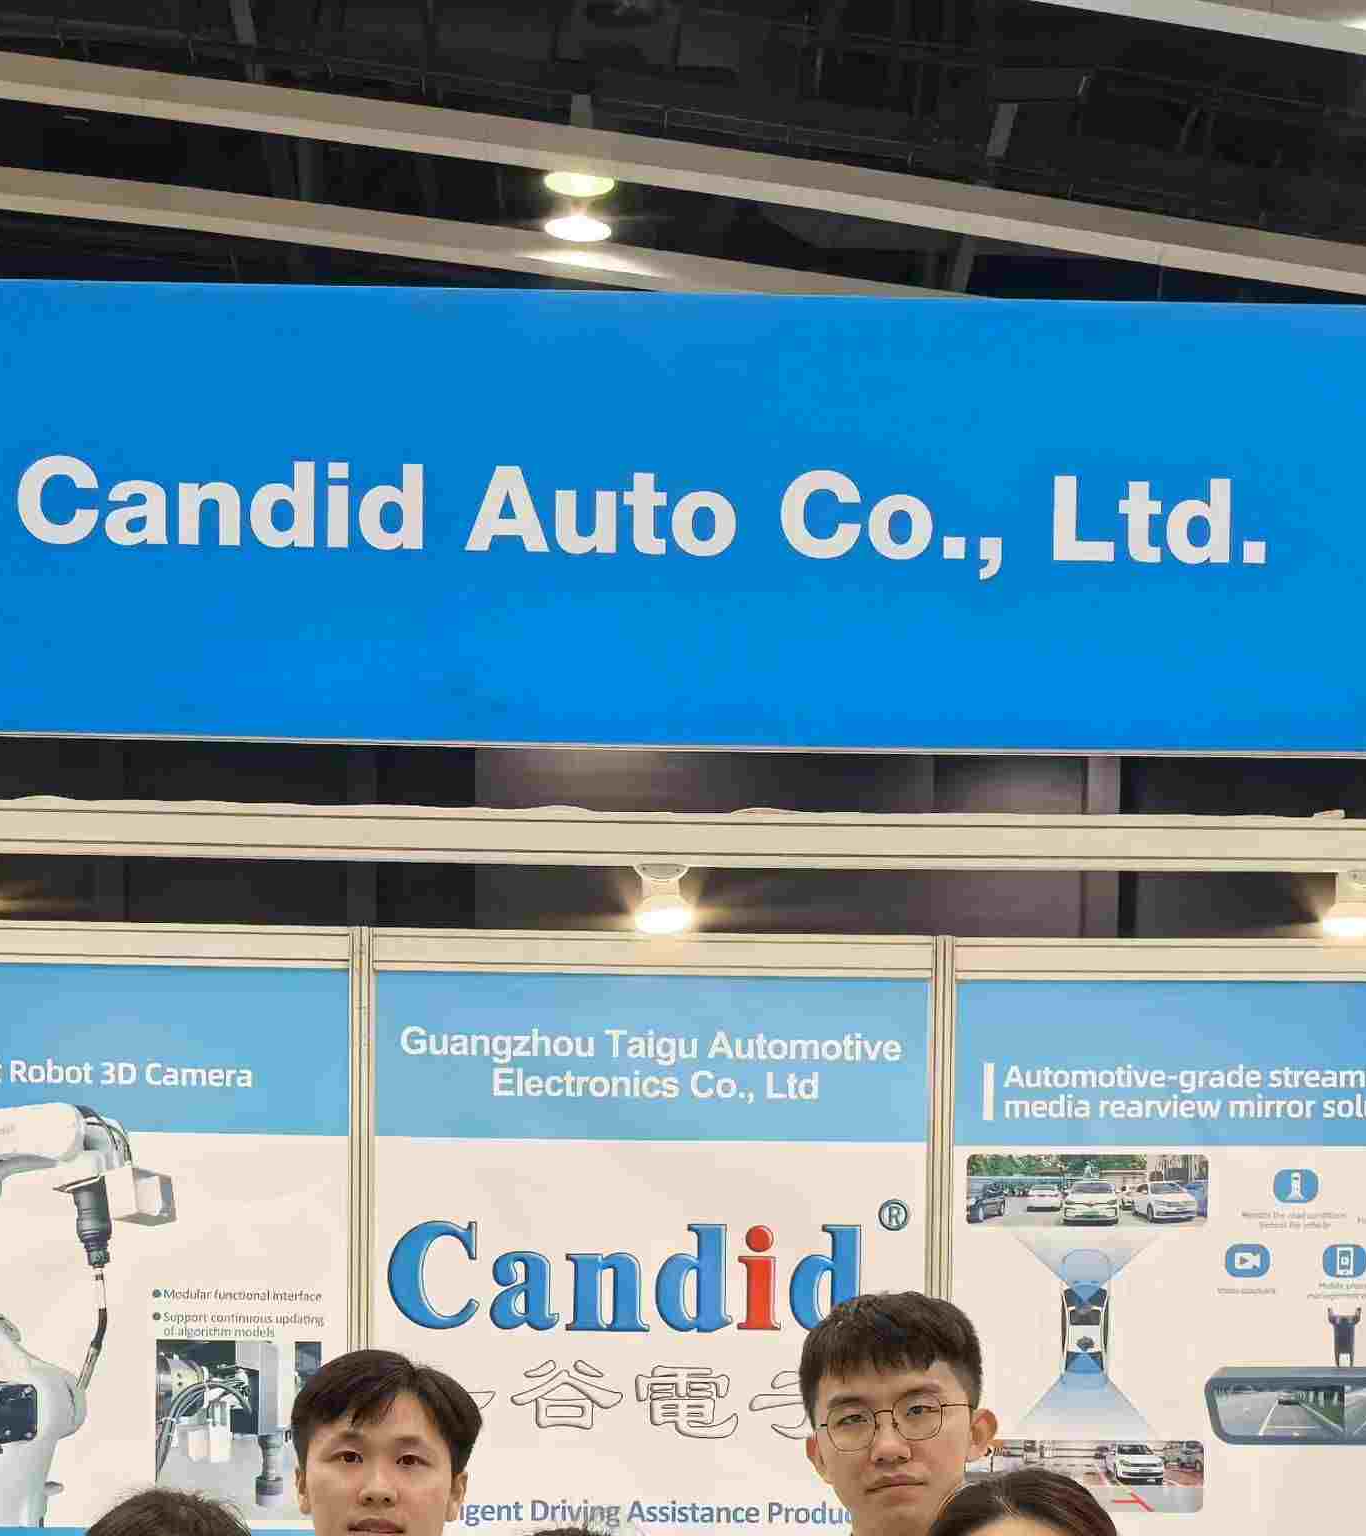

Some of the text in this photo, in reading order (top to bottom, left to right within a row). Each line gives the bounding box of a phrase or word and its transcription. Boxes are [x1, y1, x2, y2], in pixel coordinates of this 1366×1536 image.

[17, 454, 1269, 580] Candid Auto Co., Ltd.
[400, 1025, 904, 1066] Guangzhou Taigu Automotive
[10, 1059, 93, 1086] Robot
[98, 1061, 138, 1087] 3D
[145, 1062, 254, 1088] Camera
[491, 1068, 820, 1104] Electronics Co., Ltd
[1003, 1064, 1263, 1094] Automotive-grade
[1003, 1095, 1091, 1119] media
[1098, 1096, 1222, 1119] rearview
[1228, 1096, 1316, 1119] mirror
[387, 1220, 862, 1333] Candid
[530, 1500, 620, 1527] Driving
[626, 1501, 761, 1525] Assistance
